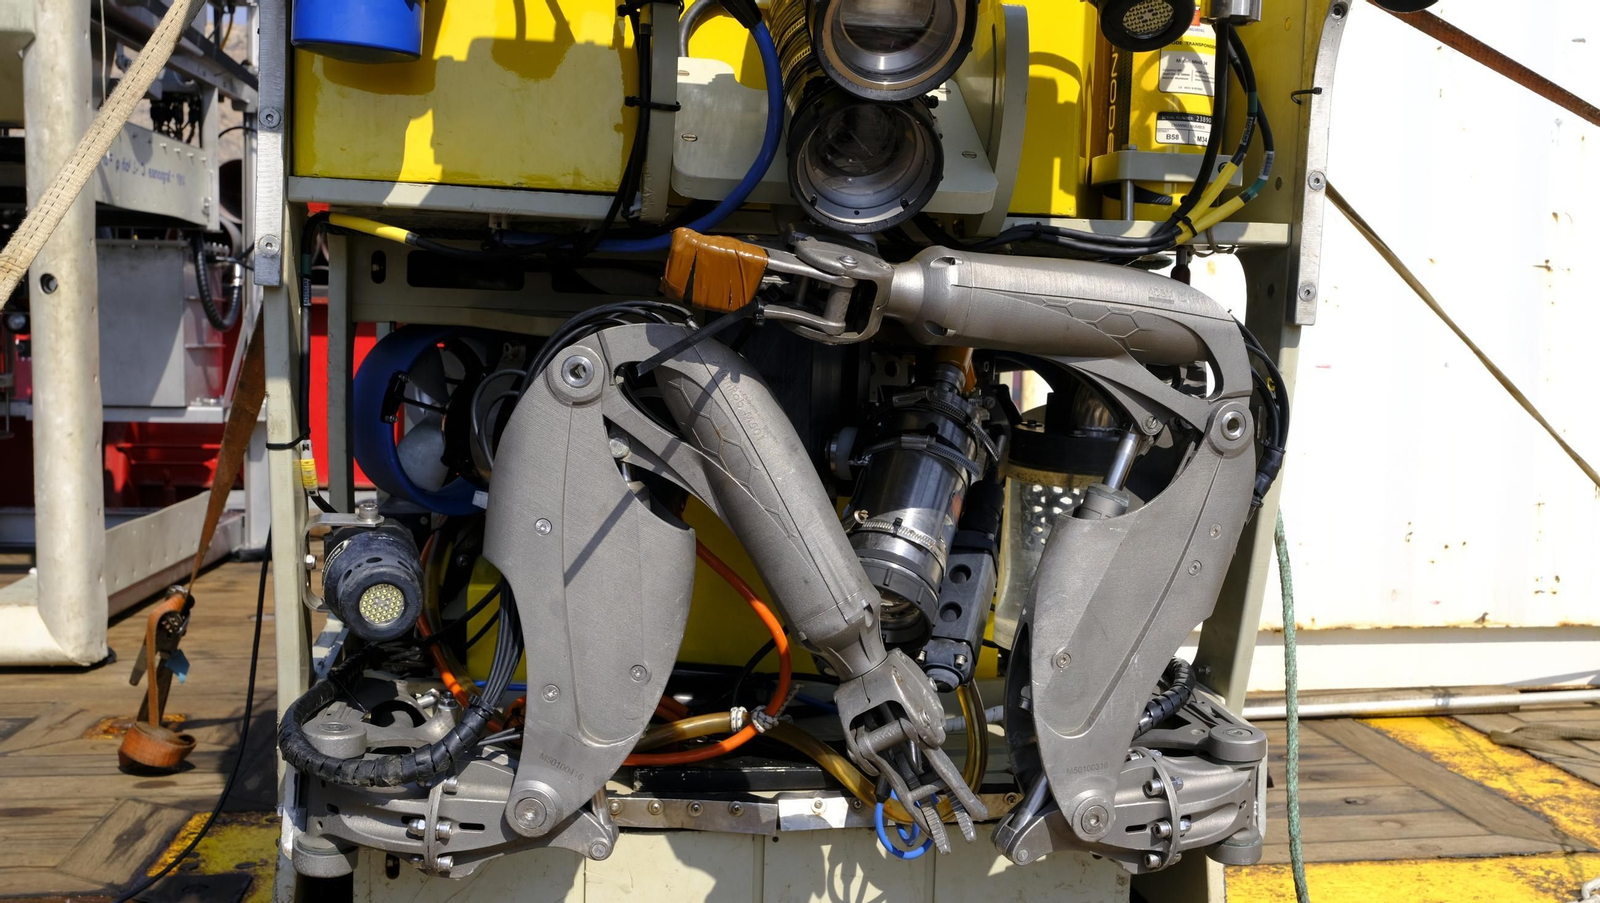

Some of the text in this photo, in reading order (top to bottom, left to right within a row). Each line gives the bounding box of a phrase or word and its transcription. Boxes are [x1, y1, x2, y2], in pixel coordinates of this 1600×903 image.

[1185, 41, 1216, 49] TRANSPONDE
[1107, 45, 1119, 154] NODE
[1195, 115, 1212, 123] 23890
[1196, 135, 1208, 143] M34
[539, 752, 585, 780] M50100416
[1066, 761, 1109, 775] M50100316
